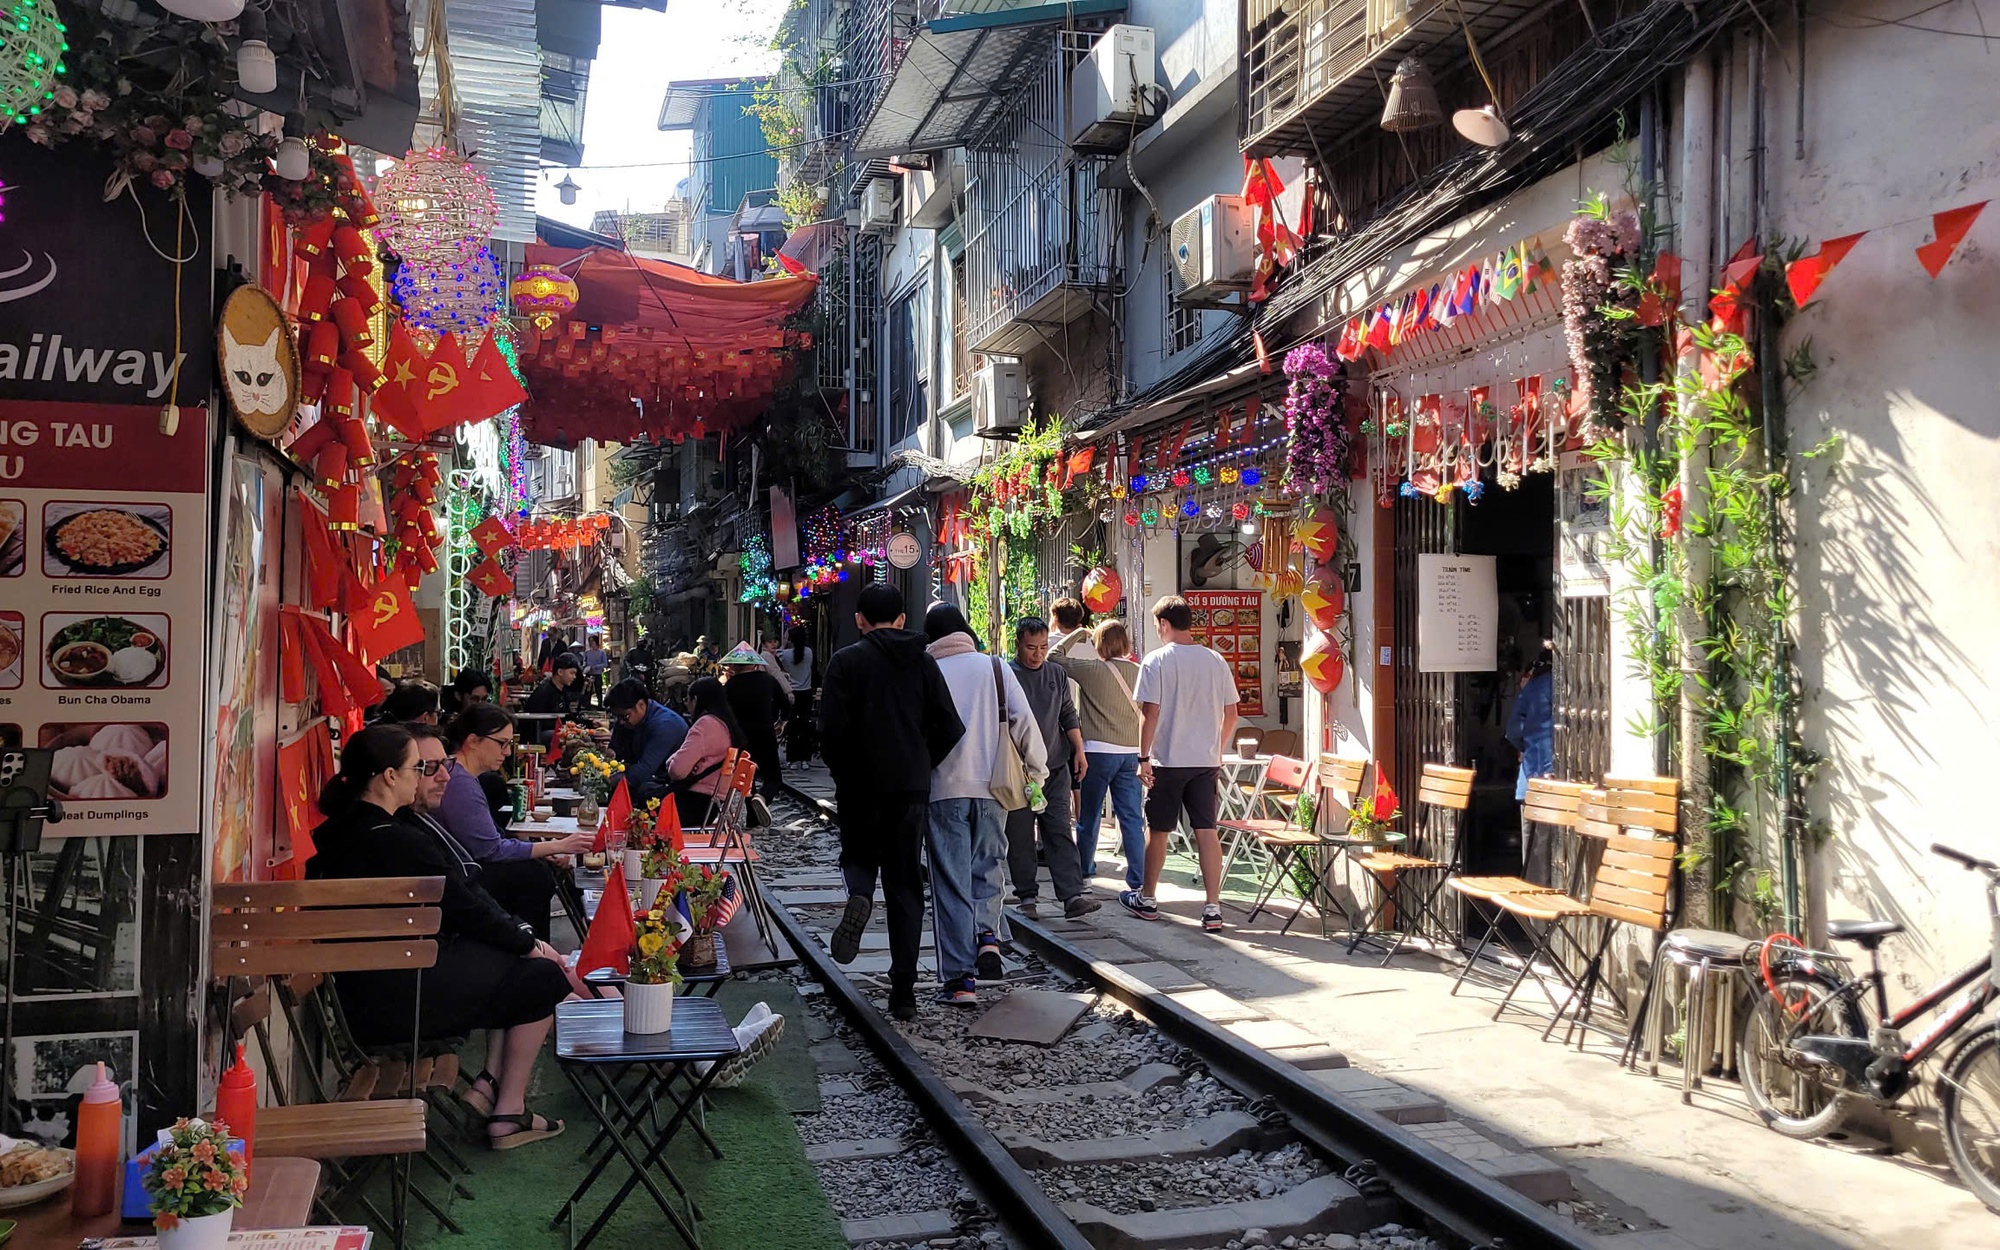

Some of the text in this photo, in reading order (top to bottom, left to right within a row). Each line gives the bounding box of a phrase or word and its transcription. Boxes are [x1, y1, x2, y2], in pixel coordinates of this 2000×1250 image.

[50, 422, 113, 449] TAU
[904, 545, 915, 553] 15
[51, 584, 161, 597] Fried Rice And Egg
[1188, 593, 1200, 606] SỐ
[1202, 596, 1208, 606] 9
[1241, 594, 1258, 606] TÀU
[58, 695, 151, 705] Bun Cha Obama
[62, 810, 149, 821] eat Dumplings
